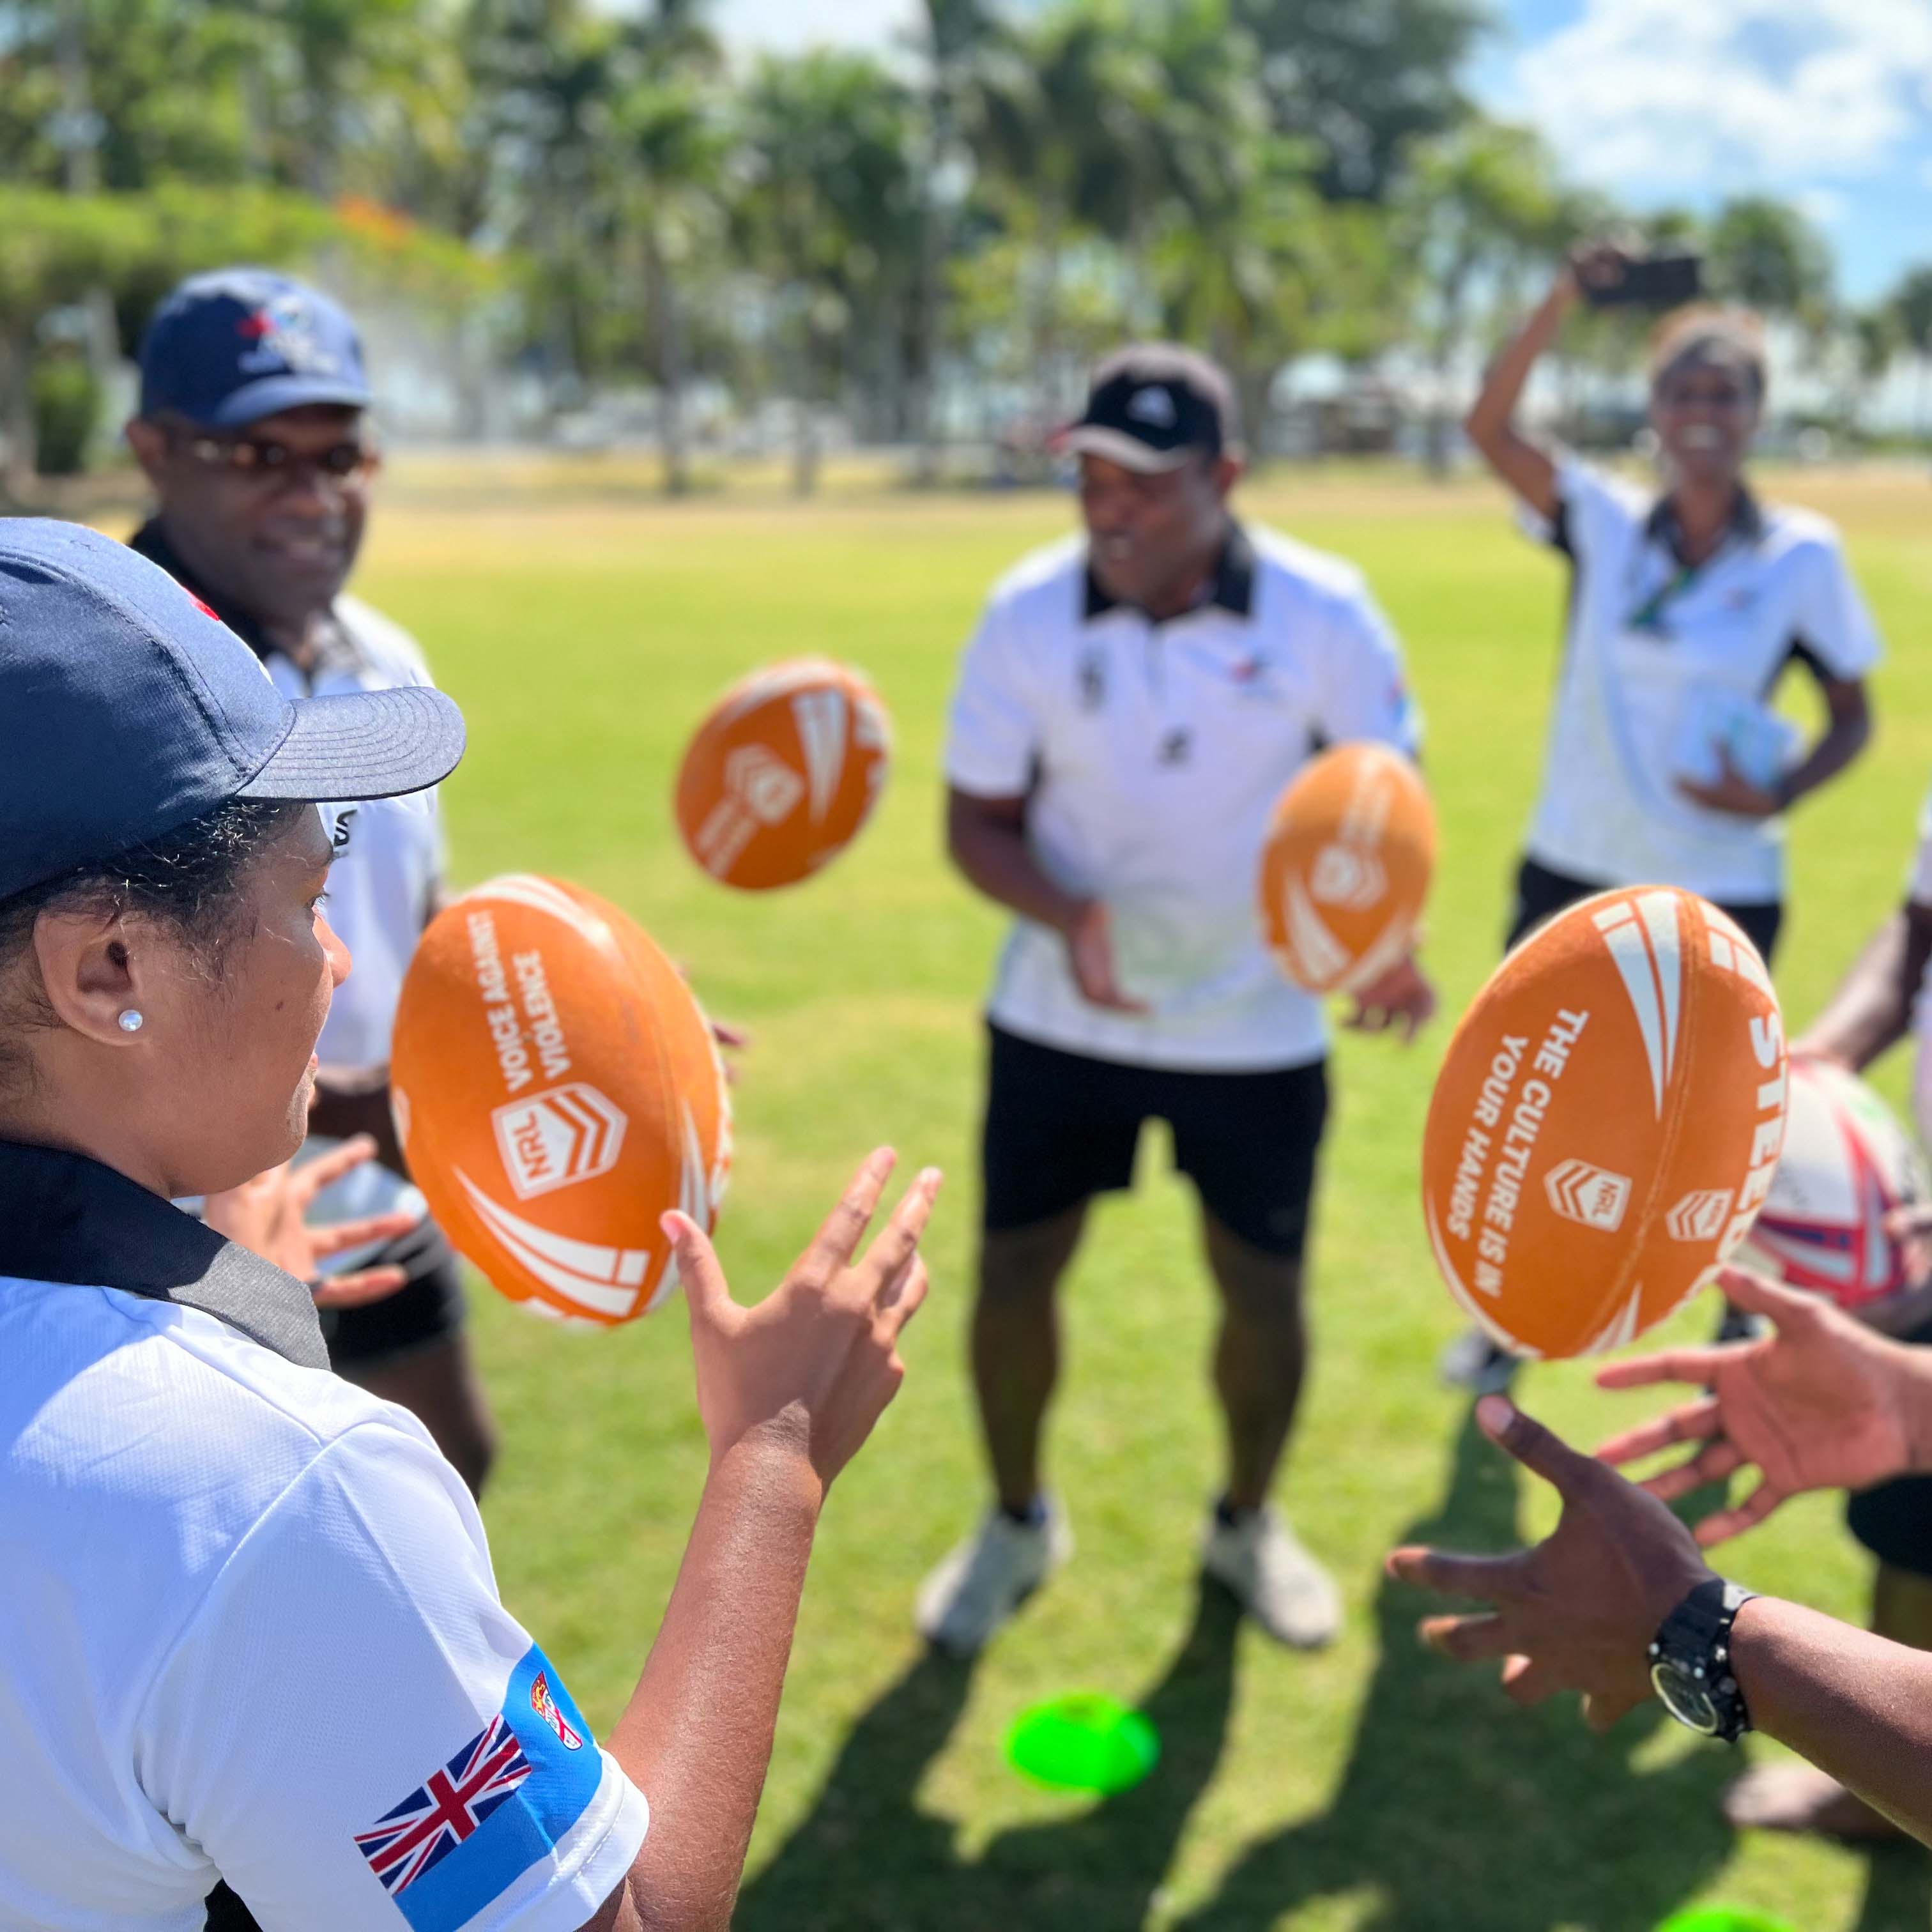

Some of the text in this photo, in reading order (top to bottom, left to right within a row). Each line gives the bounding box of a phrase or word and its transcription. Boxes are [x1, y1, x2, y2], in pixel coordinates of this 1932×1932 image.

[487, 1003, 533, 1092] VOICE
[512, 949, 571, 1080] VIOLENCE
[1533, 1008, 1590, 1080] THE
[513, 1110, 553, 1180] NRL
[1446, 1034, 1529, 1241] YOUR HANDS
[1485, 1078, 1551, 1231] CULTURE
[1592, 1180, 1619, 1217] NRL
[1478, 1226, 1508, 1265] IS
